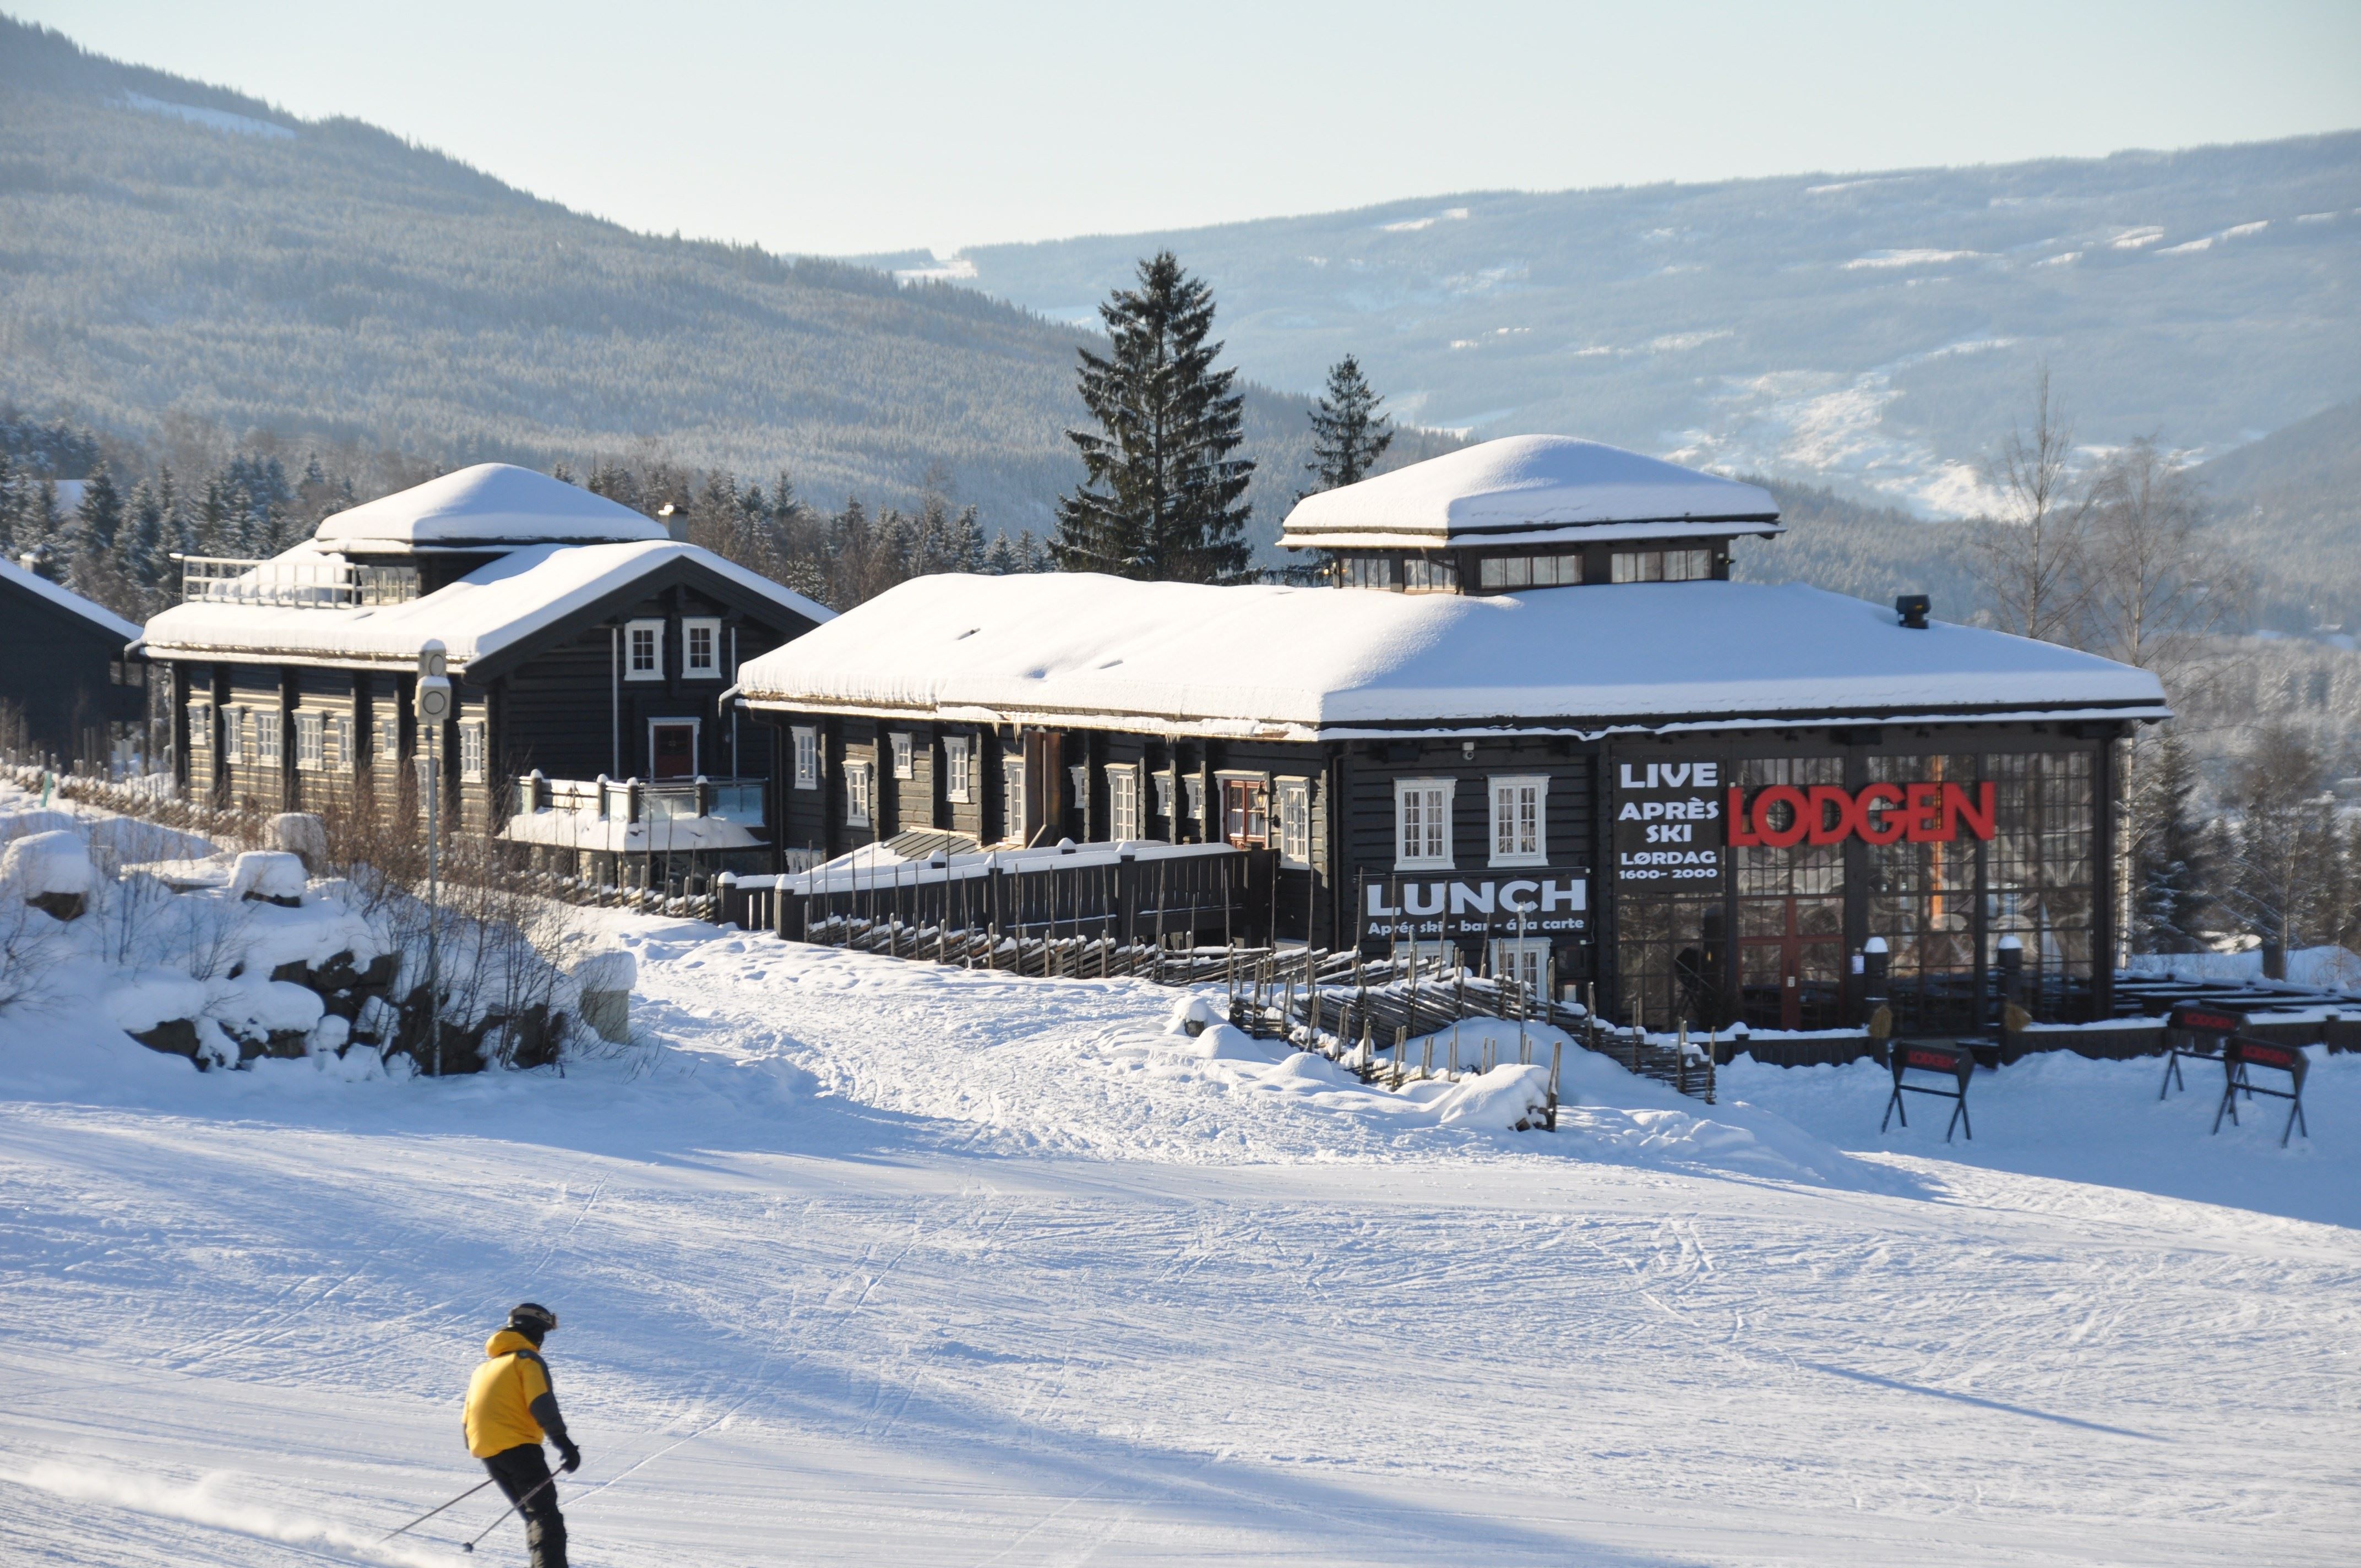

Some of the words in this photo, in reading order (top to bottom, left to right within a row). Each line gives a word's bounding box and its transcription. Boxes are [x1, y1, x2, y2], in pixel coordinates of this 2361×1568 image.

[1620, 763, 1718, 788] LIVE
[1618, 797, 1719, 820] APRÈS
[1727, 781, 1996, 848] LODGEN
[1646, 824, 1692, 843] SKI
[1620, 851, 1717, 865] LØRDAG
[1672, 868, 1718, 878] 2000
[1367, 879, 1586, 916] LUNCH
[1419, 921, 1444, 933] ski
[1460, 920, 1489, 932] bar
[1542, 918, 1584, 929] carte
